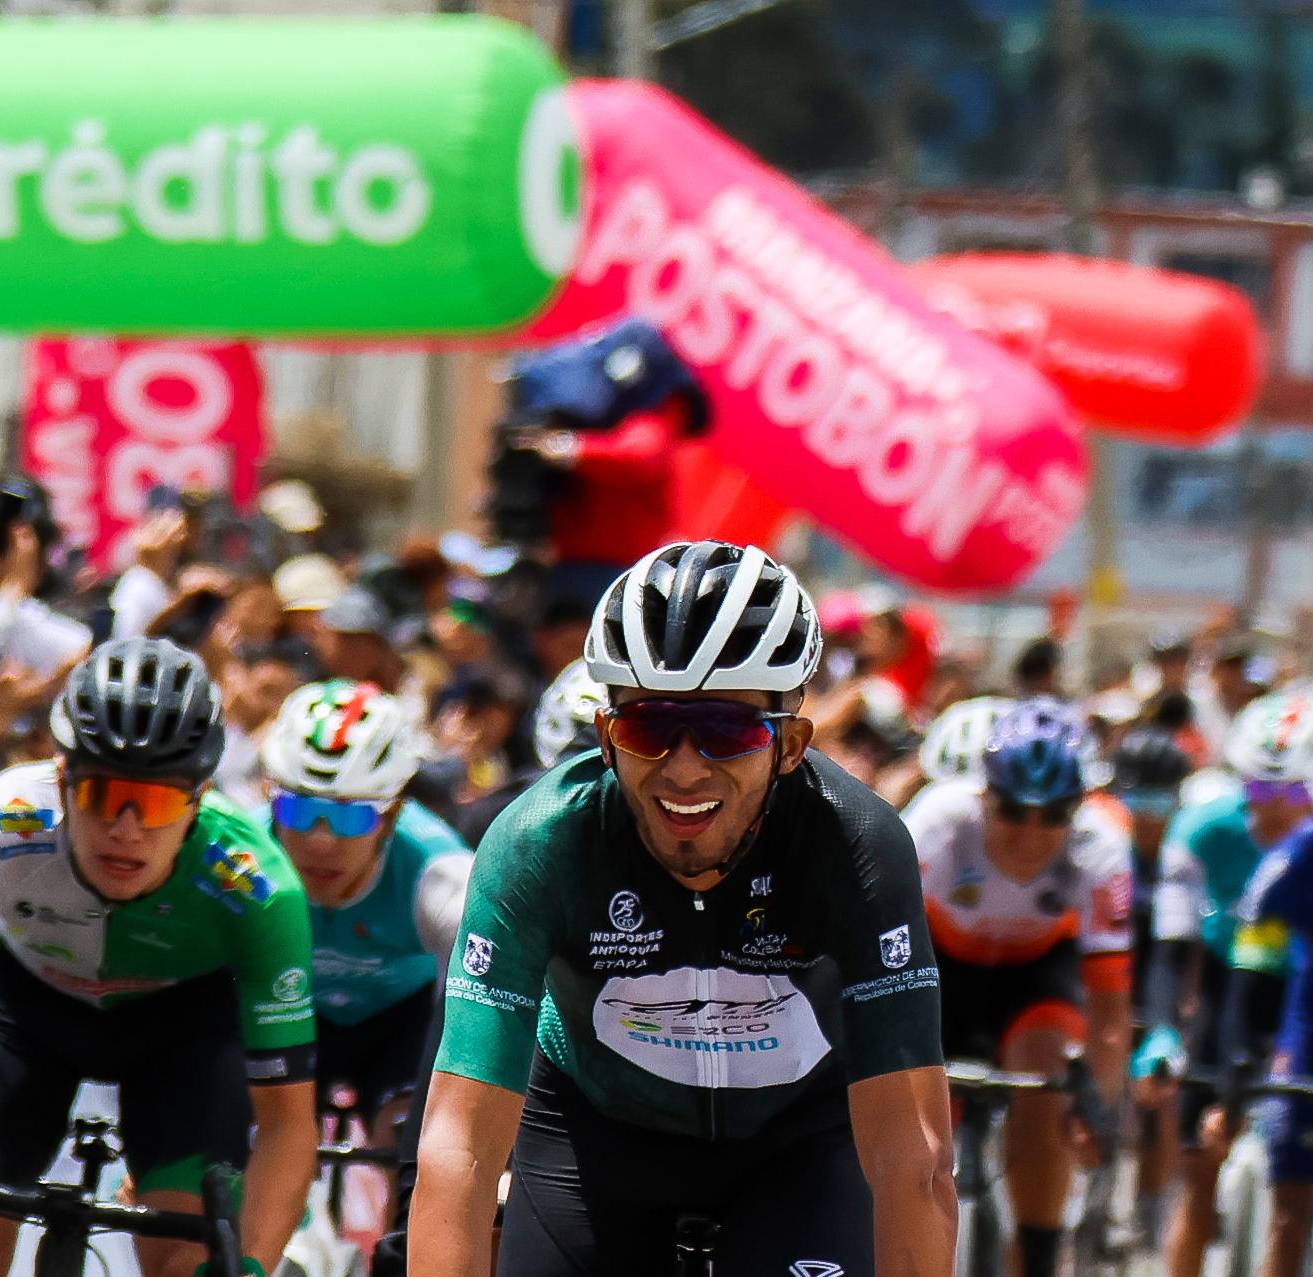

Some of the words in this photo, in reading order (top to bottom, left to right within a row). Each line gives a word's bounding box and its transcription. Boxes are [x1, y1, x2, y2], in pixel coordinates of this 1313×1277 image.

[589, 929, 664, 944] INDEPORTES
[588, 943, 661, 957] ANTIOQUIA
[591, 958, 648, 971] ETAPA
[627, 1030, 781, 1053] SHIMANO
